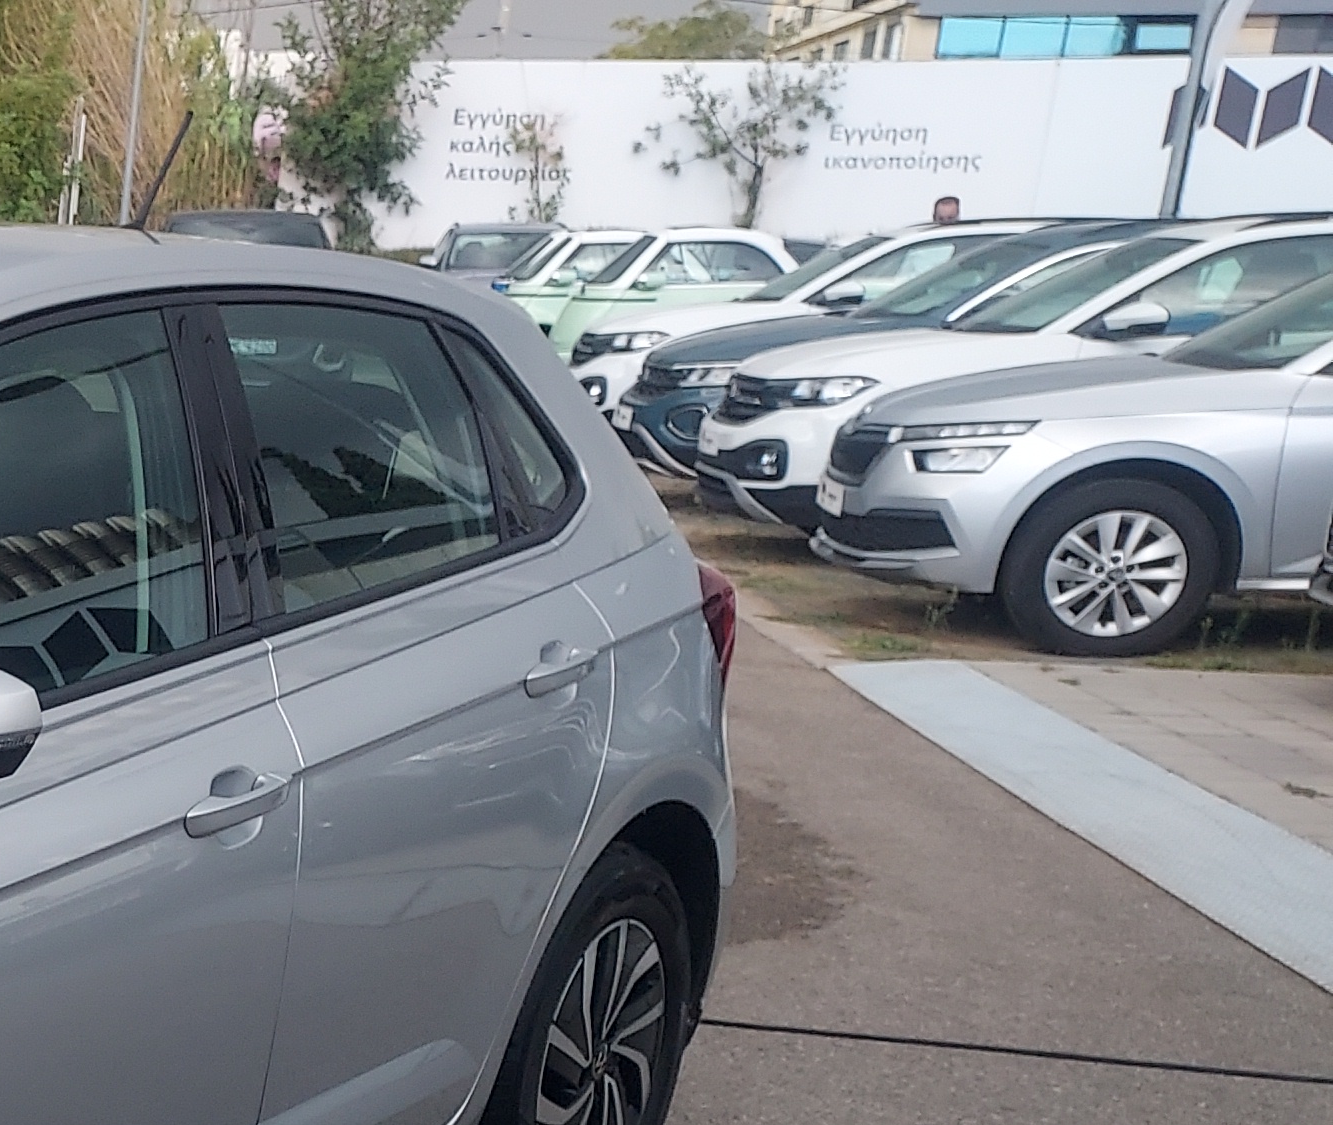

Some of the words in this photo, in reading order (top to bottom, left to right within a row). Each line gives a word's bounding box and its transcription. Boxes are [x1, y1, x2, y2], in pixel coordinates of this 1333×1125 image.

[453, 108, 545, 130] Εγγύηση
[450, 135, 512, 156] καλής
[830, 122, 928, 146] Εγγύηση
[824, 150, 982, 173] ικανοποίησης
[445, 162, 571, 185] λειτουργίας
